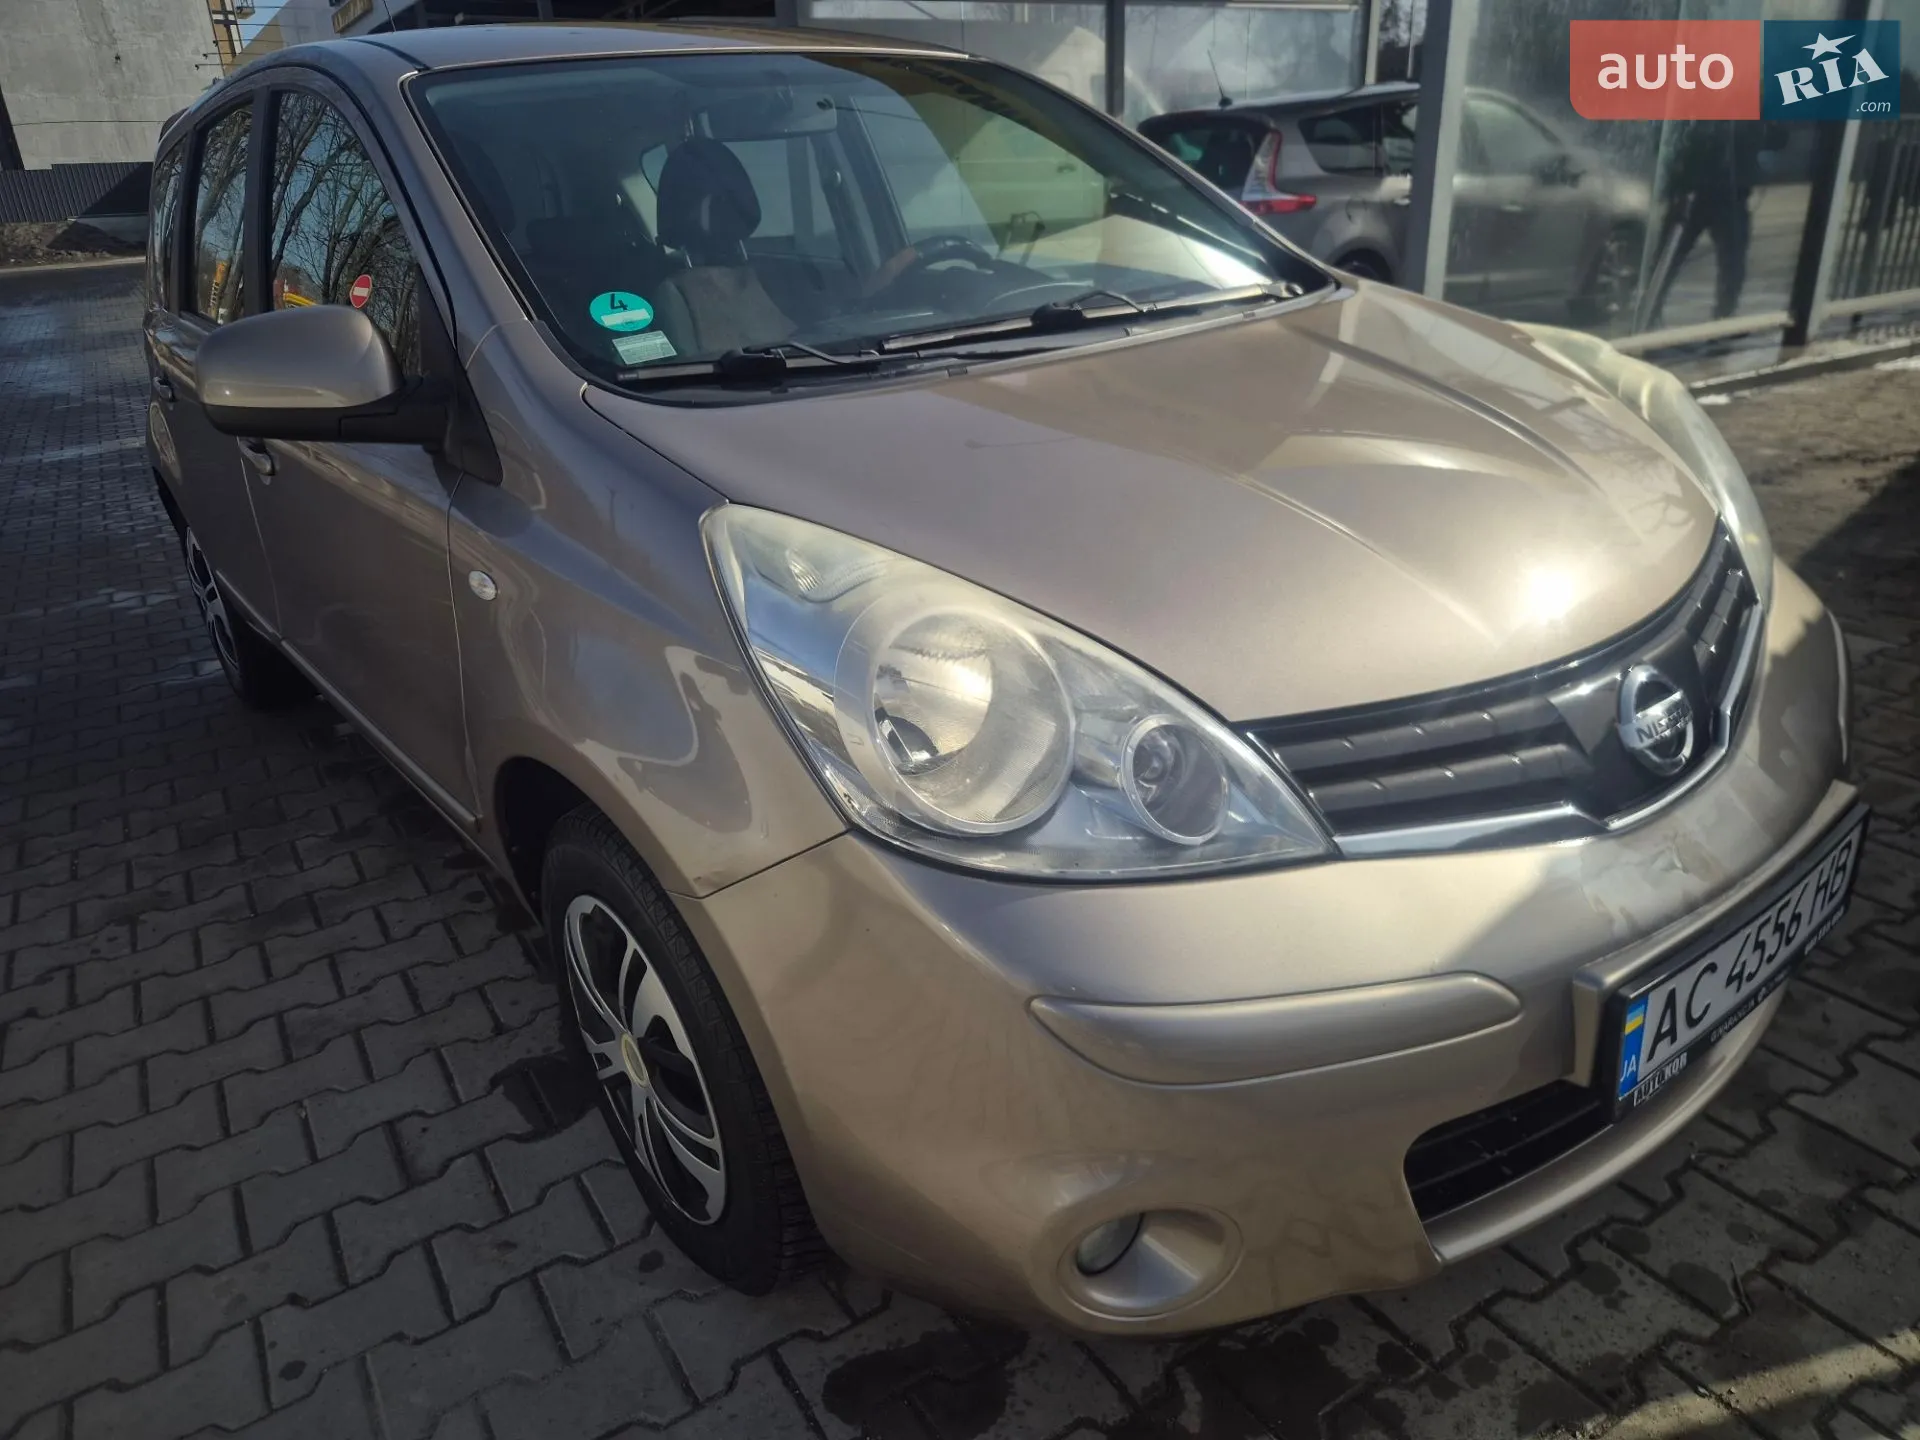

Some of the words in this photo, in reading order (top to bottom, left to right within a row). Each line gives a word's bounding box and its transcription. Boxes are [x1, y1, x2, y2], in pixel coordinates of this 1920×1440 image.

[609, 293, 629, 311] 4
[1646, 962, 1719, 1062] AC
[1724, 884, 1809, 994] 4556
[1807, 839, 1853, 927] HB
